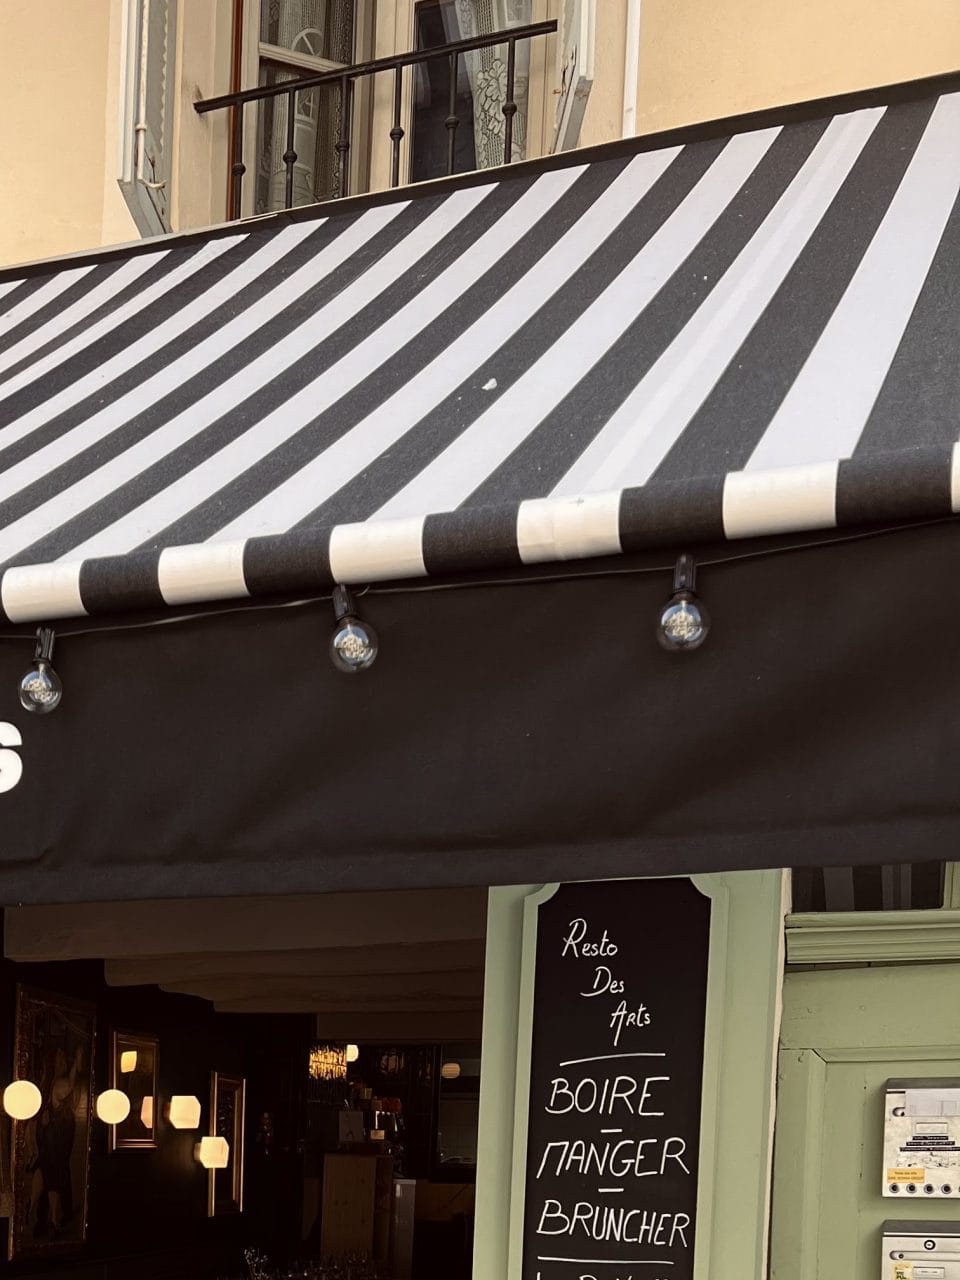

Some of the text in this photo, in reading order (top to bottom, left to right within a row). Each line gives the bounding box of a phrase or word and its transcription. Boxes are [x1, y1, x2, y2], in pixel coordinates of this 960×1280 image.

[562, 918, 618, 958] Resto
[580, 966, 625, 997] Des
[545, 1076, 670, 1116] BOIRE
[536, 1137, 690, 1179] MANGER
[536, 1199, 690, 1248] BRUNCHER
